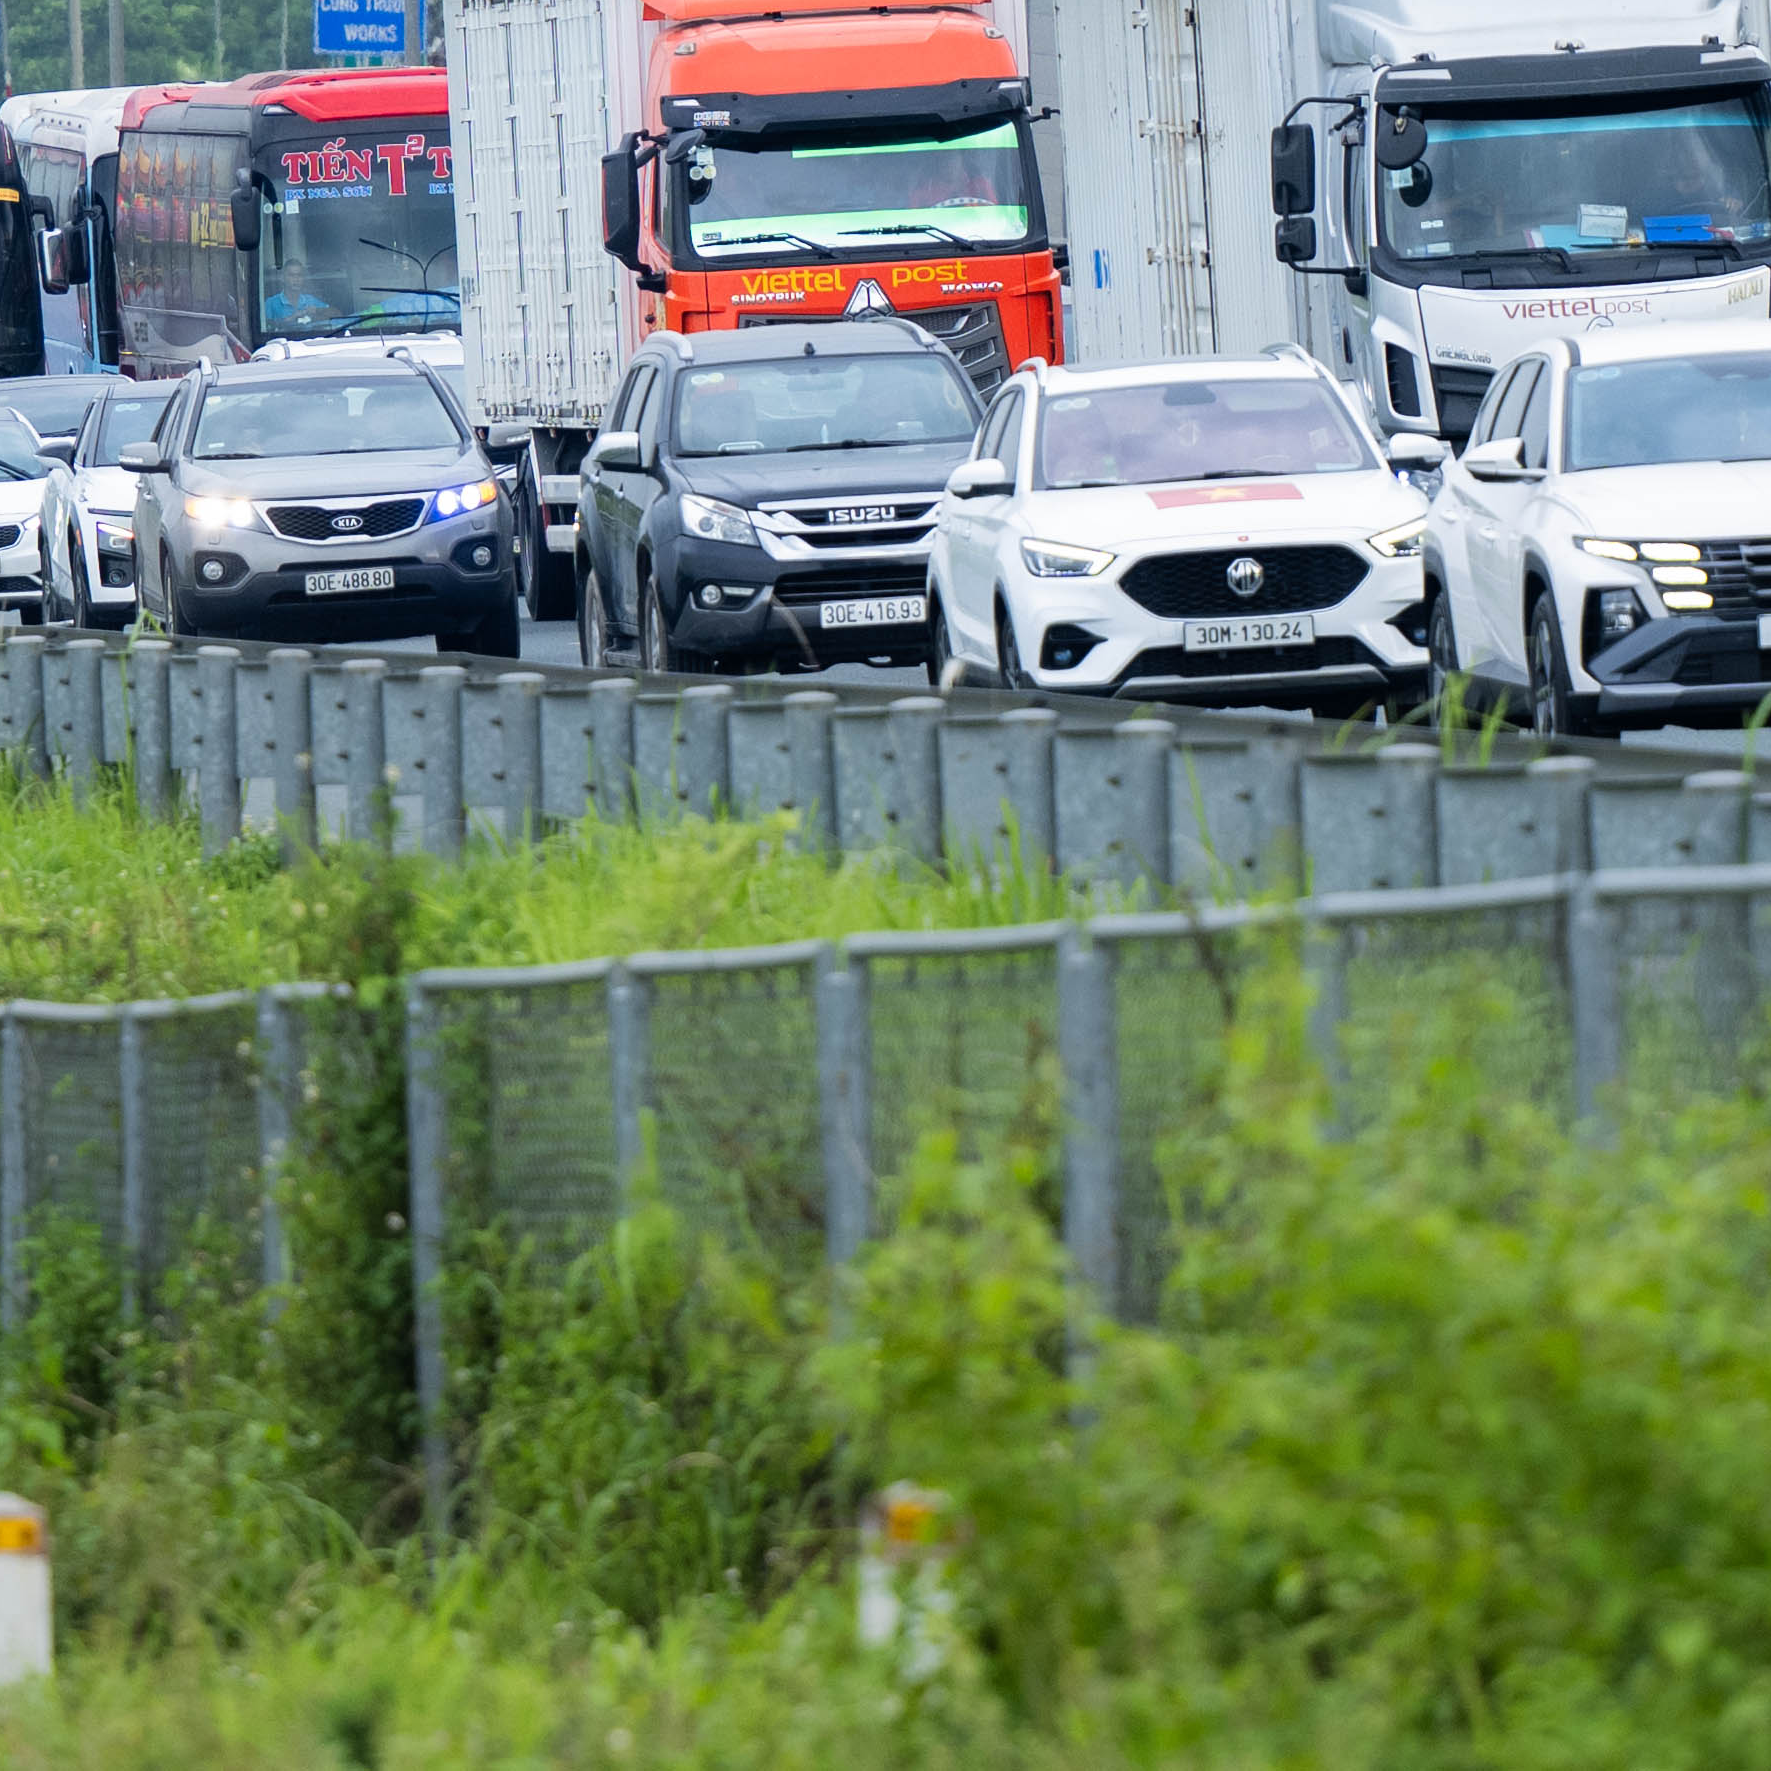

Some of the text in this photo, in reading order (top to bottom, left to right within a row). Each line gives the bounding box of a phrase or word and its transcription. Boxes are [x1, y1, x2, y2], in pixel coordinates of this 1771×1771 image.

[344, 24, 398, 43] WORKS
[281, 136, 374, 184] TIẾN
[741, 260, 968, 295] viettel post
[731, 291, 806, 307] SINOTRUK
[1502, 297, 1652, 319] viettel post
[337, 518, 358, 528] KIA
[828, 506, 896, 523] ISUZU
[308, 570, 392, 592] 30E-488.80
[1231, 560, 1261, 591] MG
[824, 599, 922, 624] 30E-416.93
[1196, 621, 1303, 645] 30M-130.24
